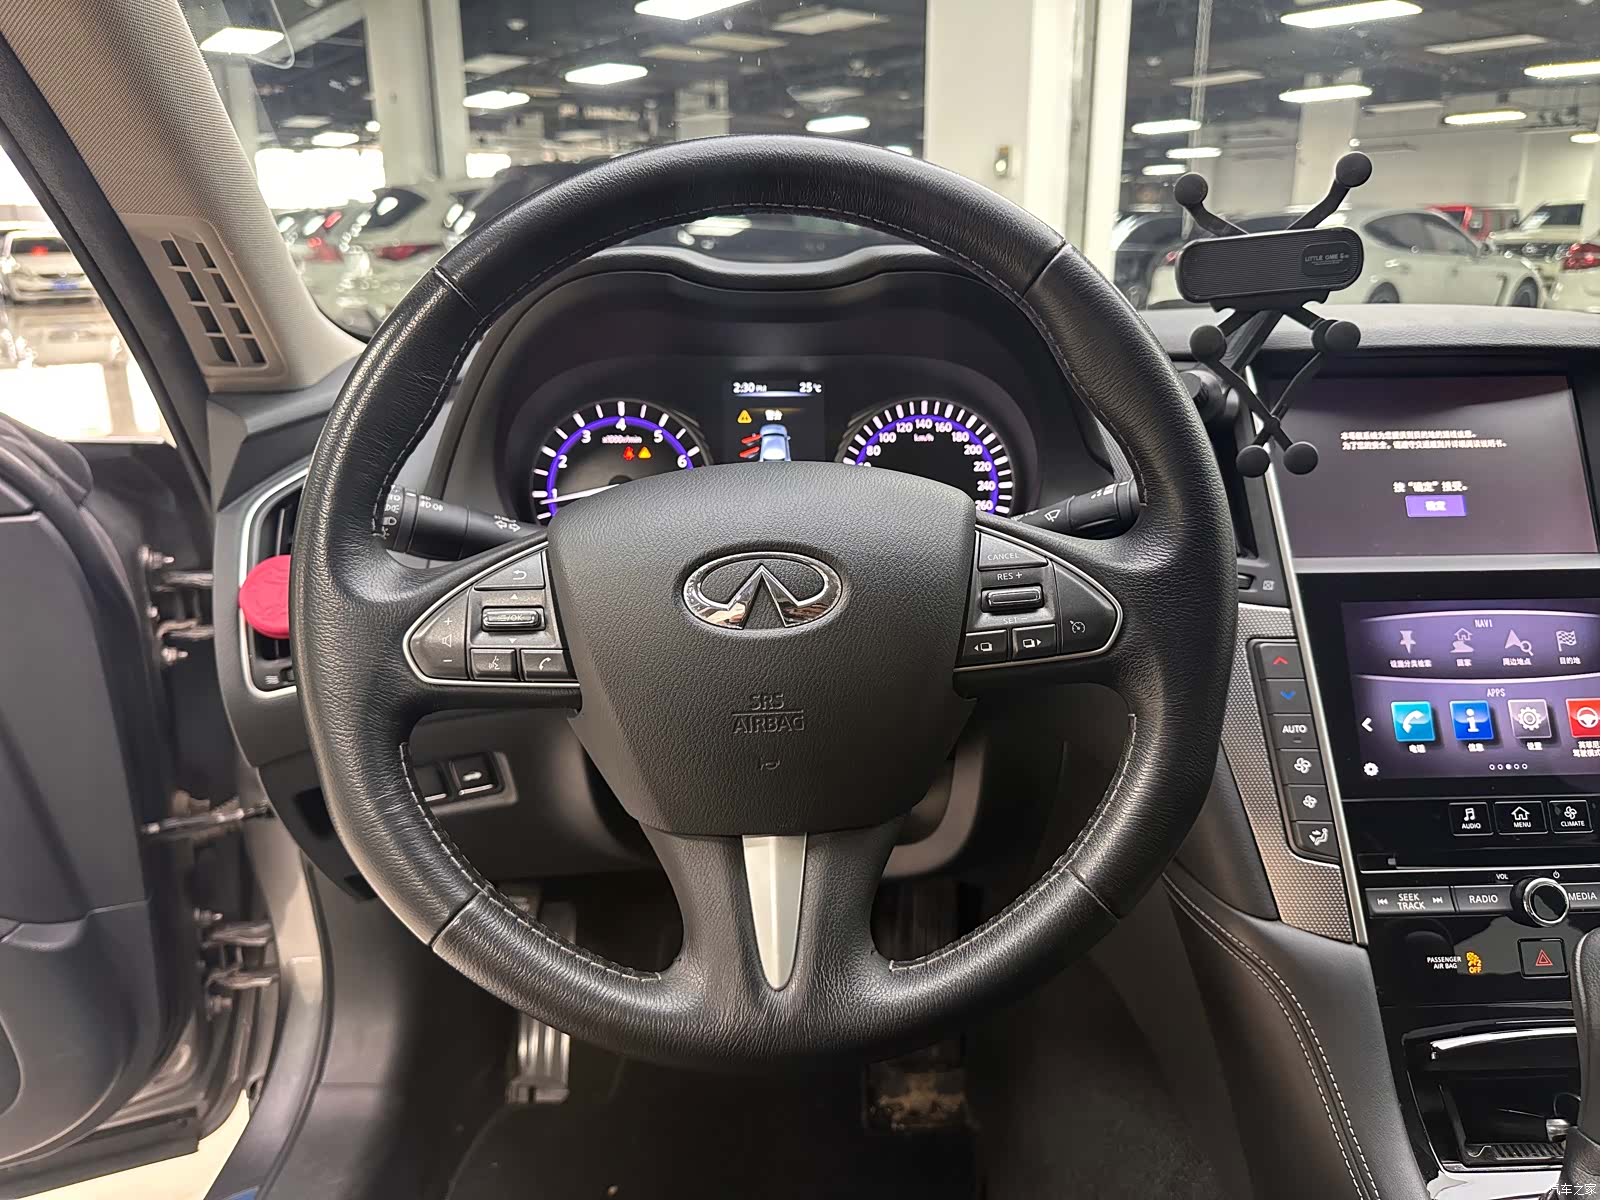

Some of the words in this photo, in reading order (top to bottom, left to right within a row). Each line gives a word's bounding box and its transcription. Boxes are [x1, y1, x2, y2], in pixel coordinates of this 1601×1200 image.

[733, 382, 755, 393] 2:30
[615, 417, 627, 431] 4
[896, 421, 913, 433] 120
[915, 418, 933, 429] 140
[935, 421, 953, 433] 160
[581, 429, 592, 443] 3
[653, 429, 664, 443] 5
[878, 432, 897, 443] 100
[951, 431, 970, 443] 180
[866, 445, 881, 456] 80
[963, 444, 983, 455] 200
[557, 454, 568, 468] 2
[677, 454, 688, 468] 6
[973, 461, 992, 472] 220
[977, 480, 996, 492] 240
[975, 500, 994, 511] 260
[987, 552, 1020, 561] CANCEL
[997, 573, 1013, 581] RES
[1003, 617, 1019, 625] SET
[1474, 619, 1493, 628] NAVI
[1559, 656, 1581, 665] 目的地
[1487, 688, 1506, 698] APPS
[750, 692, 785, 711] SRS
[732, 715, 805, 733] AIRBAG
[1282, 724, 1307, 734] AUTO
[1526, 741, 1543, 751] 设置
[1578, 740, 1600, 749] 英菲尼
[1398, 893, 1420, 901] SEEK
[1468, 895, 1498, 904] RADIO
[1568, 891, 1598, 901] MEDIA
[1397, 901, 1426, 910] TRACK
[1468, 966, 1482, 974] OFF
